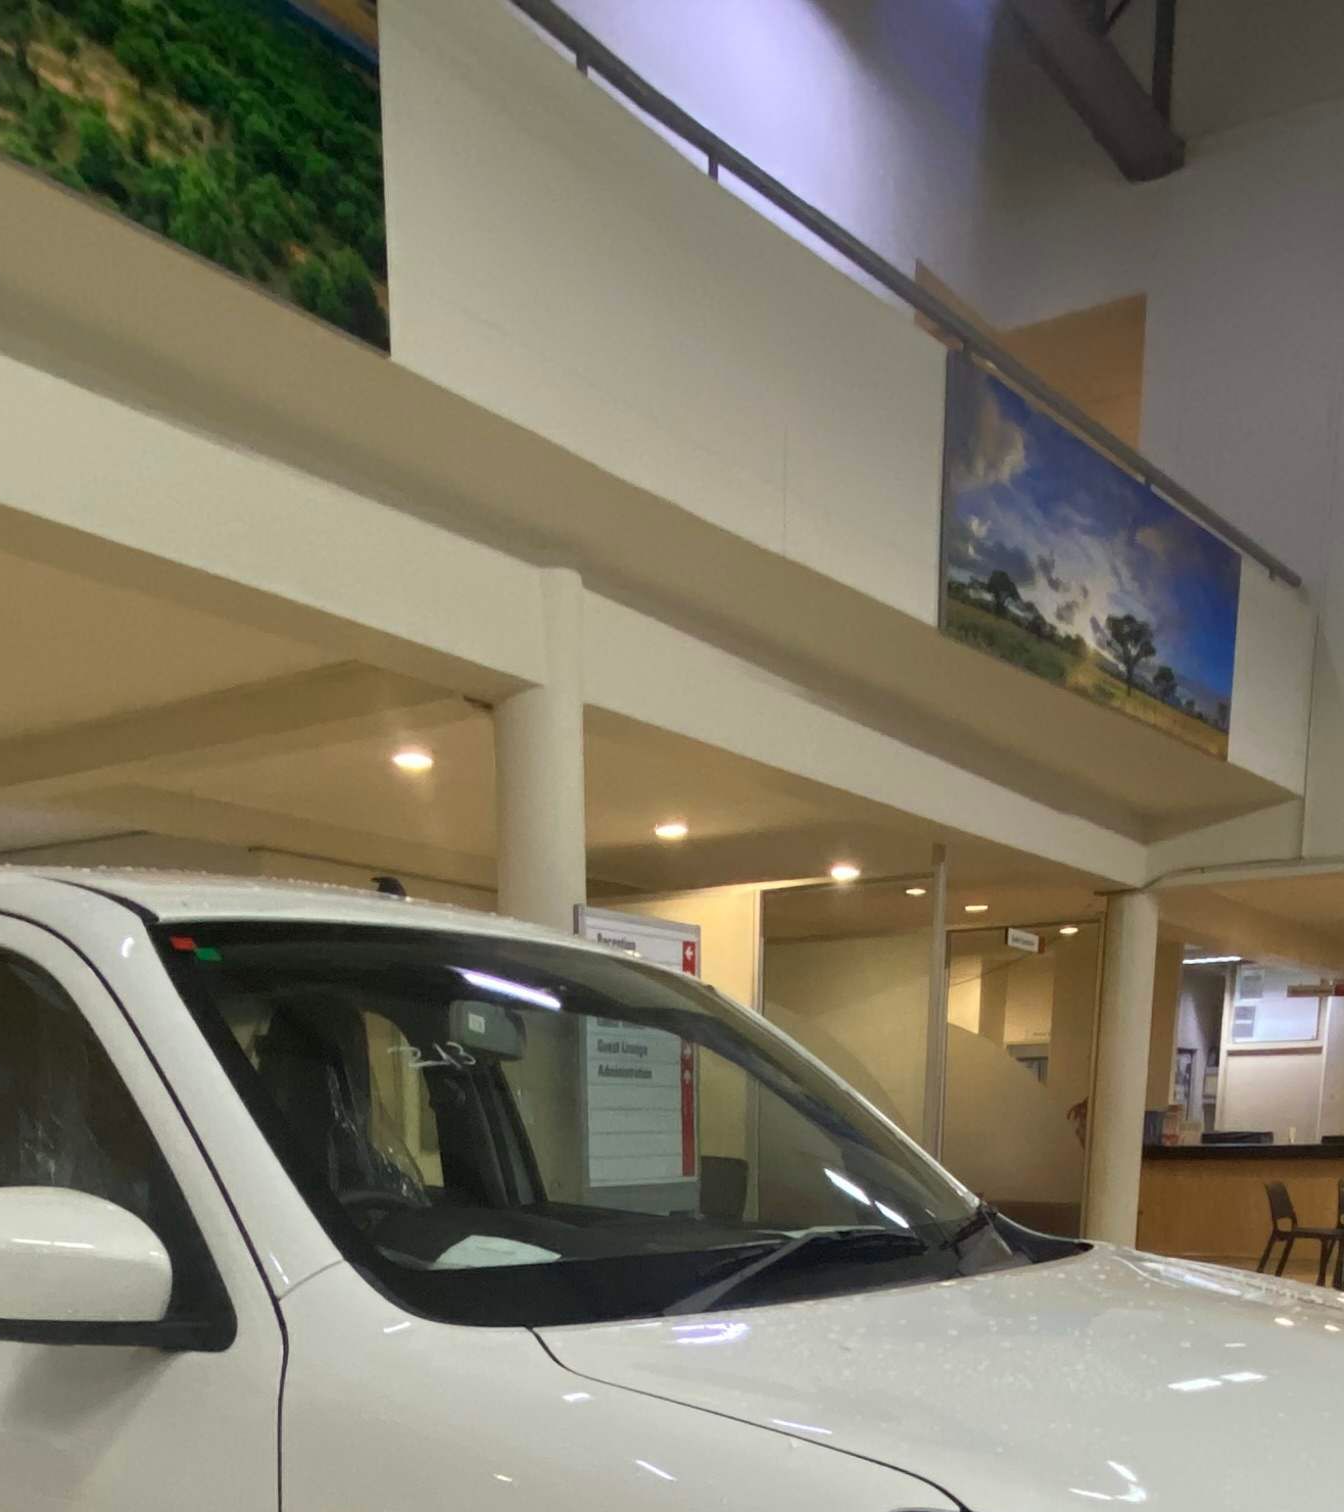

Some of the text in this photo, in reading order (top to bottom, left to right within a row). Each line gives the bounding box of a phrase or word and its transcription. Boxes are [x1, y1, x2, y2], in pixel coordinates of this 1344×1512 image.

[597, 932, 636, 951] Reception
[597, 1038, 648, 1058] Guest Lounge
[598, 1063, 653, 1079] Administration
